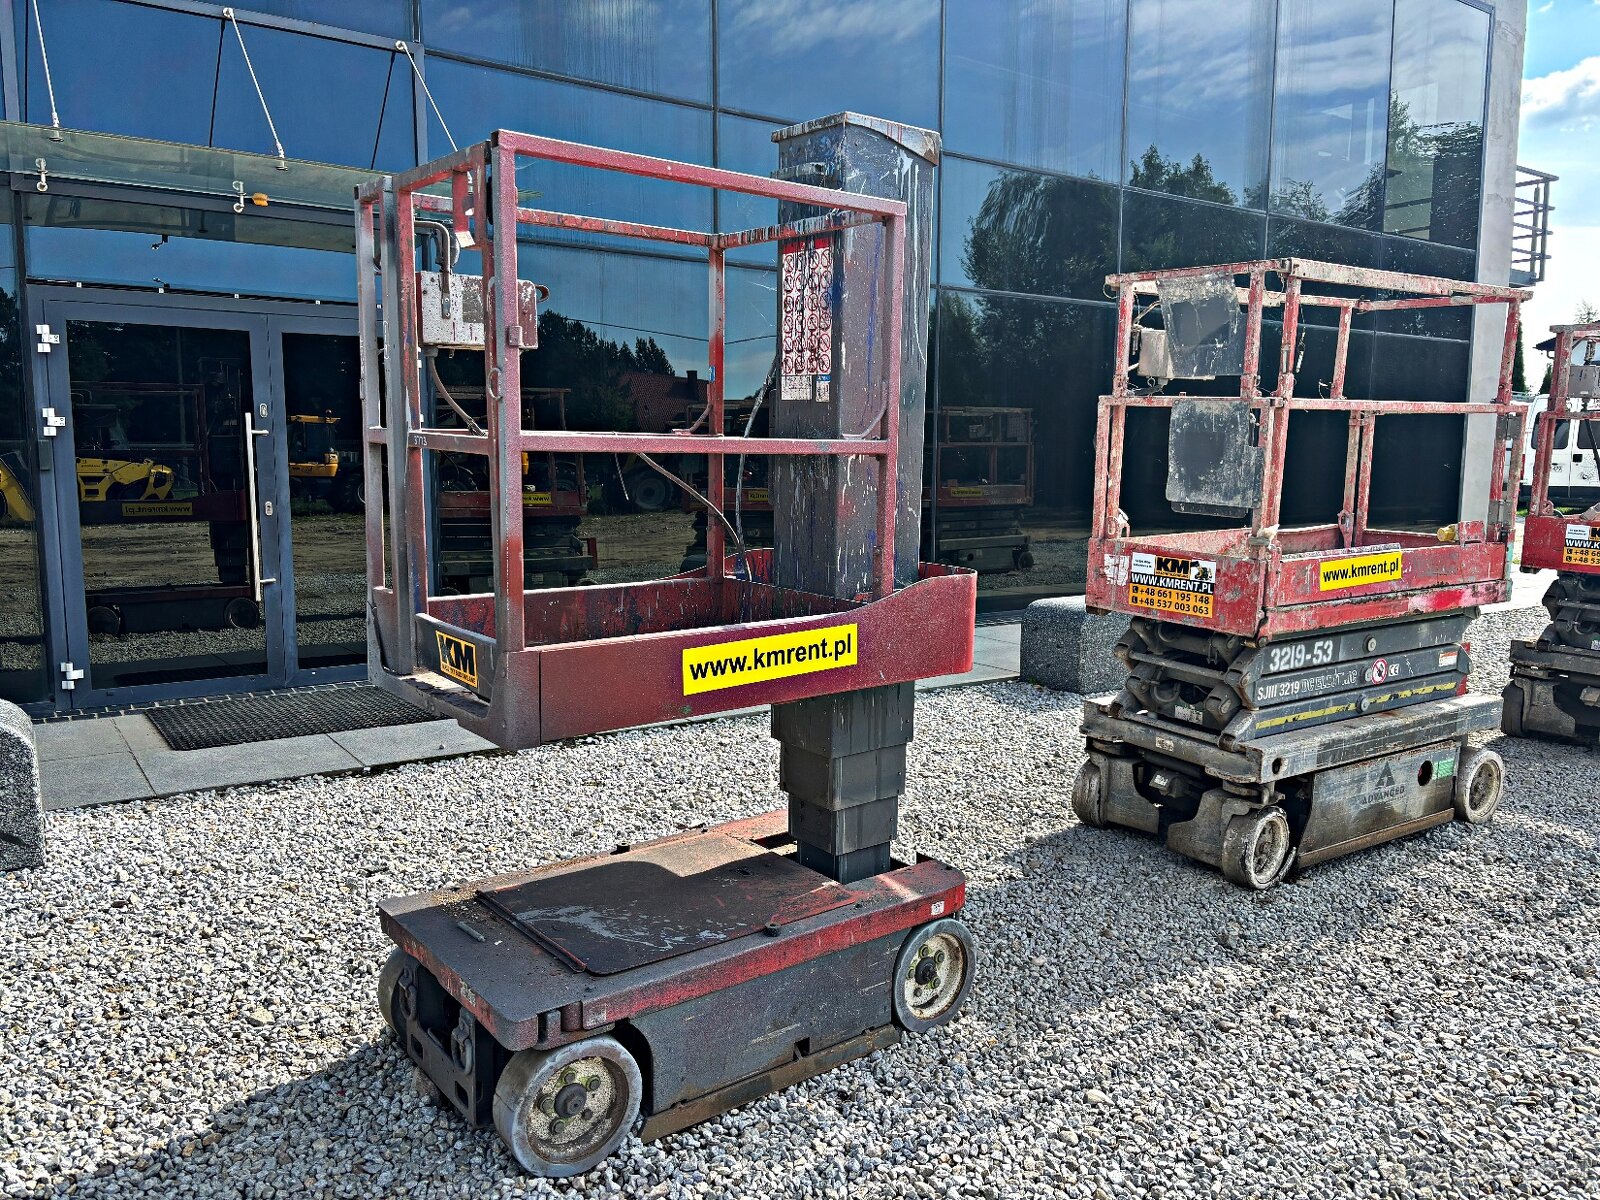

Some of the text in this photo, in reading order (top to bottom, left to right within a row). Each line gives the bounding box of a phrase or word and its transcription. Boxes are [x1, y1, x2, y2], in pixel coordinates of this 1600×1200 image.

[1156, 557, 1190, 575] KM
[1323, 558, 1399, 582] www.kmrent.pl
[1131, 573, 1213, 594] WWW.KMRENT.PL
[1139, 597, 1209, 615] +48 537 003 063
[1140, 587, 1210, 605] +48 661 195 148
[438, 634, 476, 677] KM
[689, 633, 852, 681] www.kmrent.pl
[1269, 640, 1334, 672] 3219-53
[1279, 681, 1300, 696] 3219
